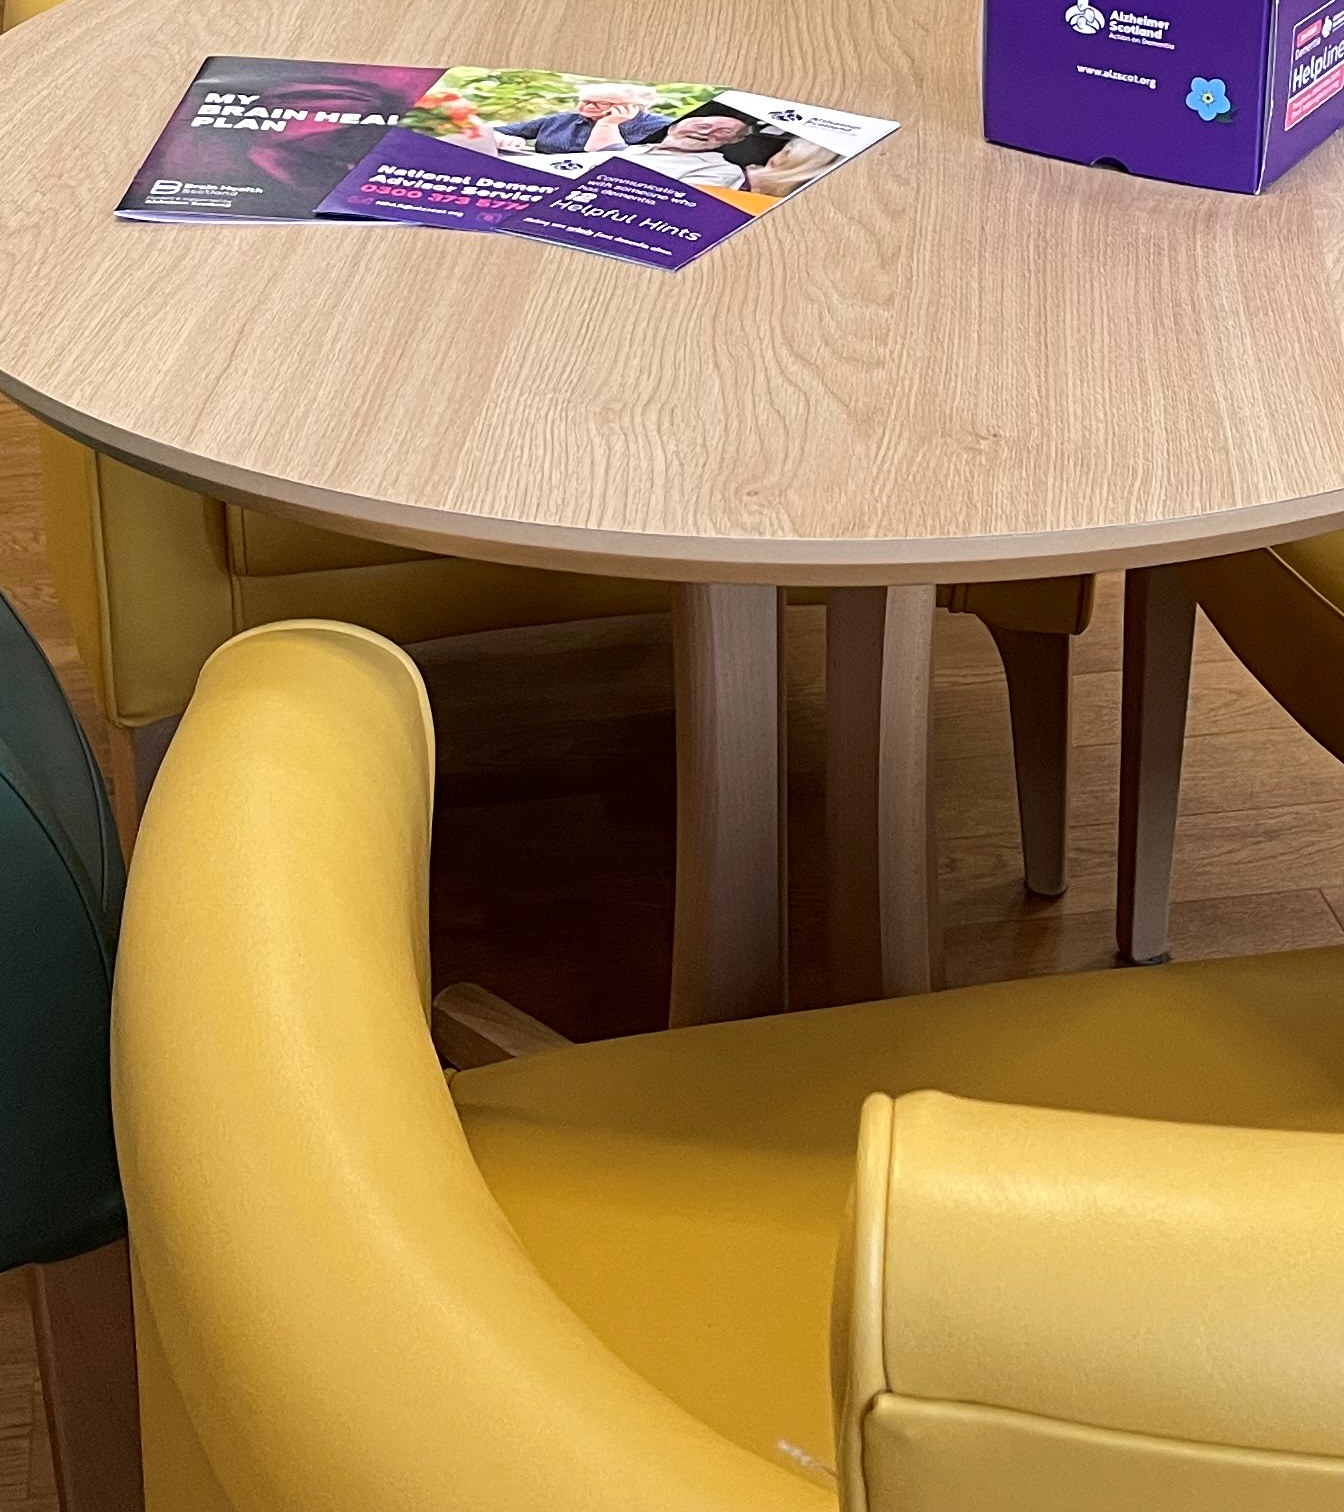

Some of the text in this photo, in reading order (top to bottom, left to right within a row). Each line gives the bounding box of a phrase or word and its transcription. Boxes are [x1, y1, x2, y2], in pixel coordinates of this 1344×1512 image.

[1109, 10, 1171, 30] Alzheimer
[1109, 20, 1163, 40] Scotland
[1108, 32, 1131, 42] Action
[1141, 37, 1175, 50] Dementia
[1076, 64, 1156, 89] www.alzscot.org
[204, 92, 260, 105] MY
[197, 105, 308, 121] BRAIN
[191, 116, 287, 132] PLAN
[220, 185, 263, 193] Health
[368, 174, 544, 203] Advisor Service
[377, 164, 559, 194] National Demen
[596, 174, 687, 198] Communicating
[181, 189, 238, 197] Scotland
[360, 183, 423, 199] 0300
[428, 192, 471, 205] 373
[564, 190, 598, 204] 12
[577, 184, 657, 206] has dementia
[587, 180, 698, 208] with someone who
[549, 198, 702, 242] Helpful Hints
